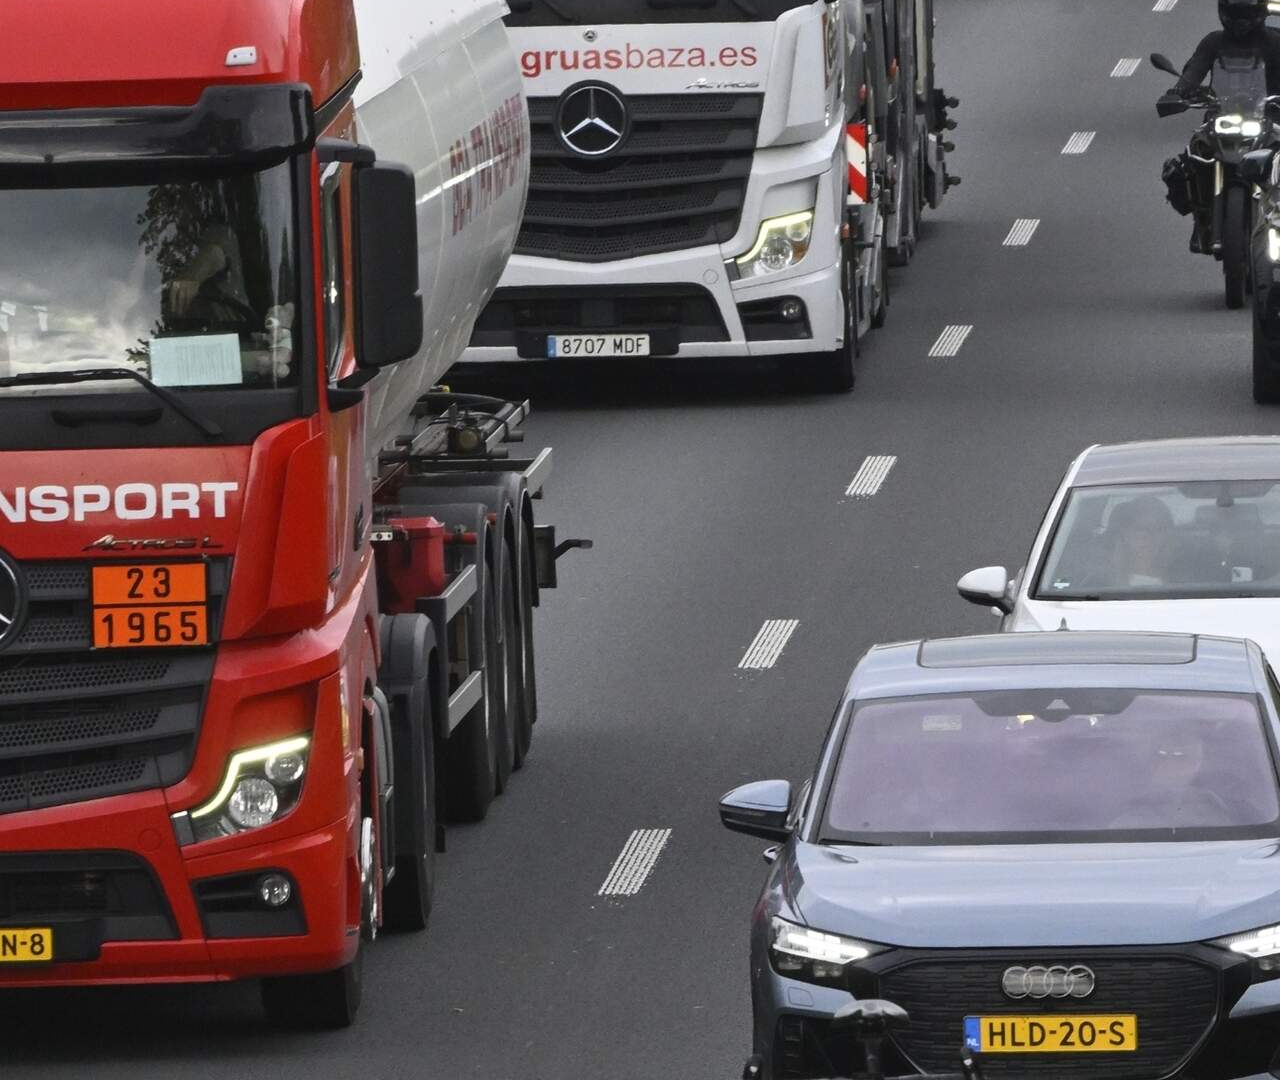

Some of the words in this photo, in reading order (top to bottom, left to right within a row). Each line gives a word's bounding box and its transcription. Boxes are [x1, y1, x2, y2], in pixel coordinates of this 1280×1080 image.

[520, 42, 758, 78] gruasbaza.es
[562, 338, 606, 355] 8707
[613, 337, 646, 354] MDF
[127, 567, 171, 599] 23
[102, 611, 198, 644] 1965
[988, 1020, 1125, 1047] HLD-20-S
